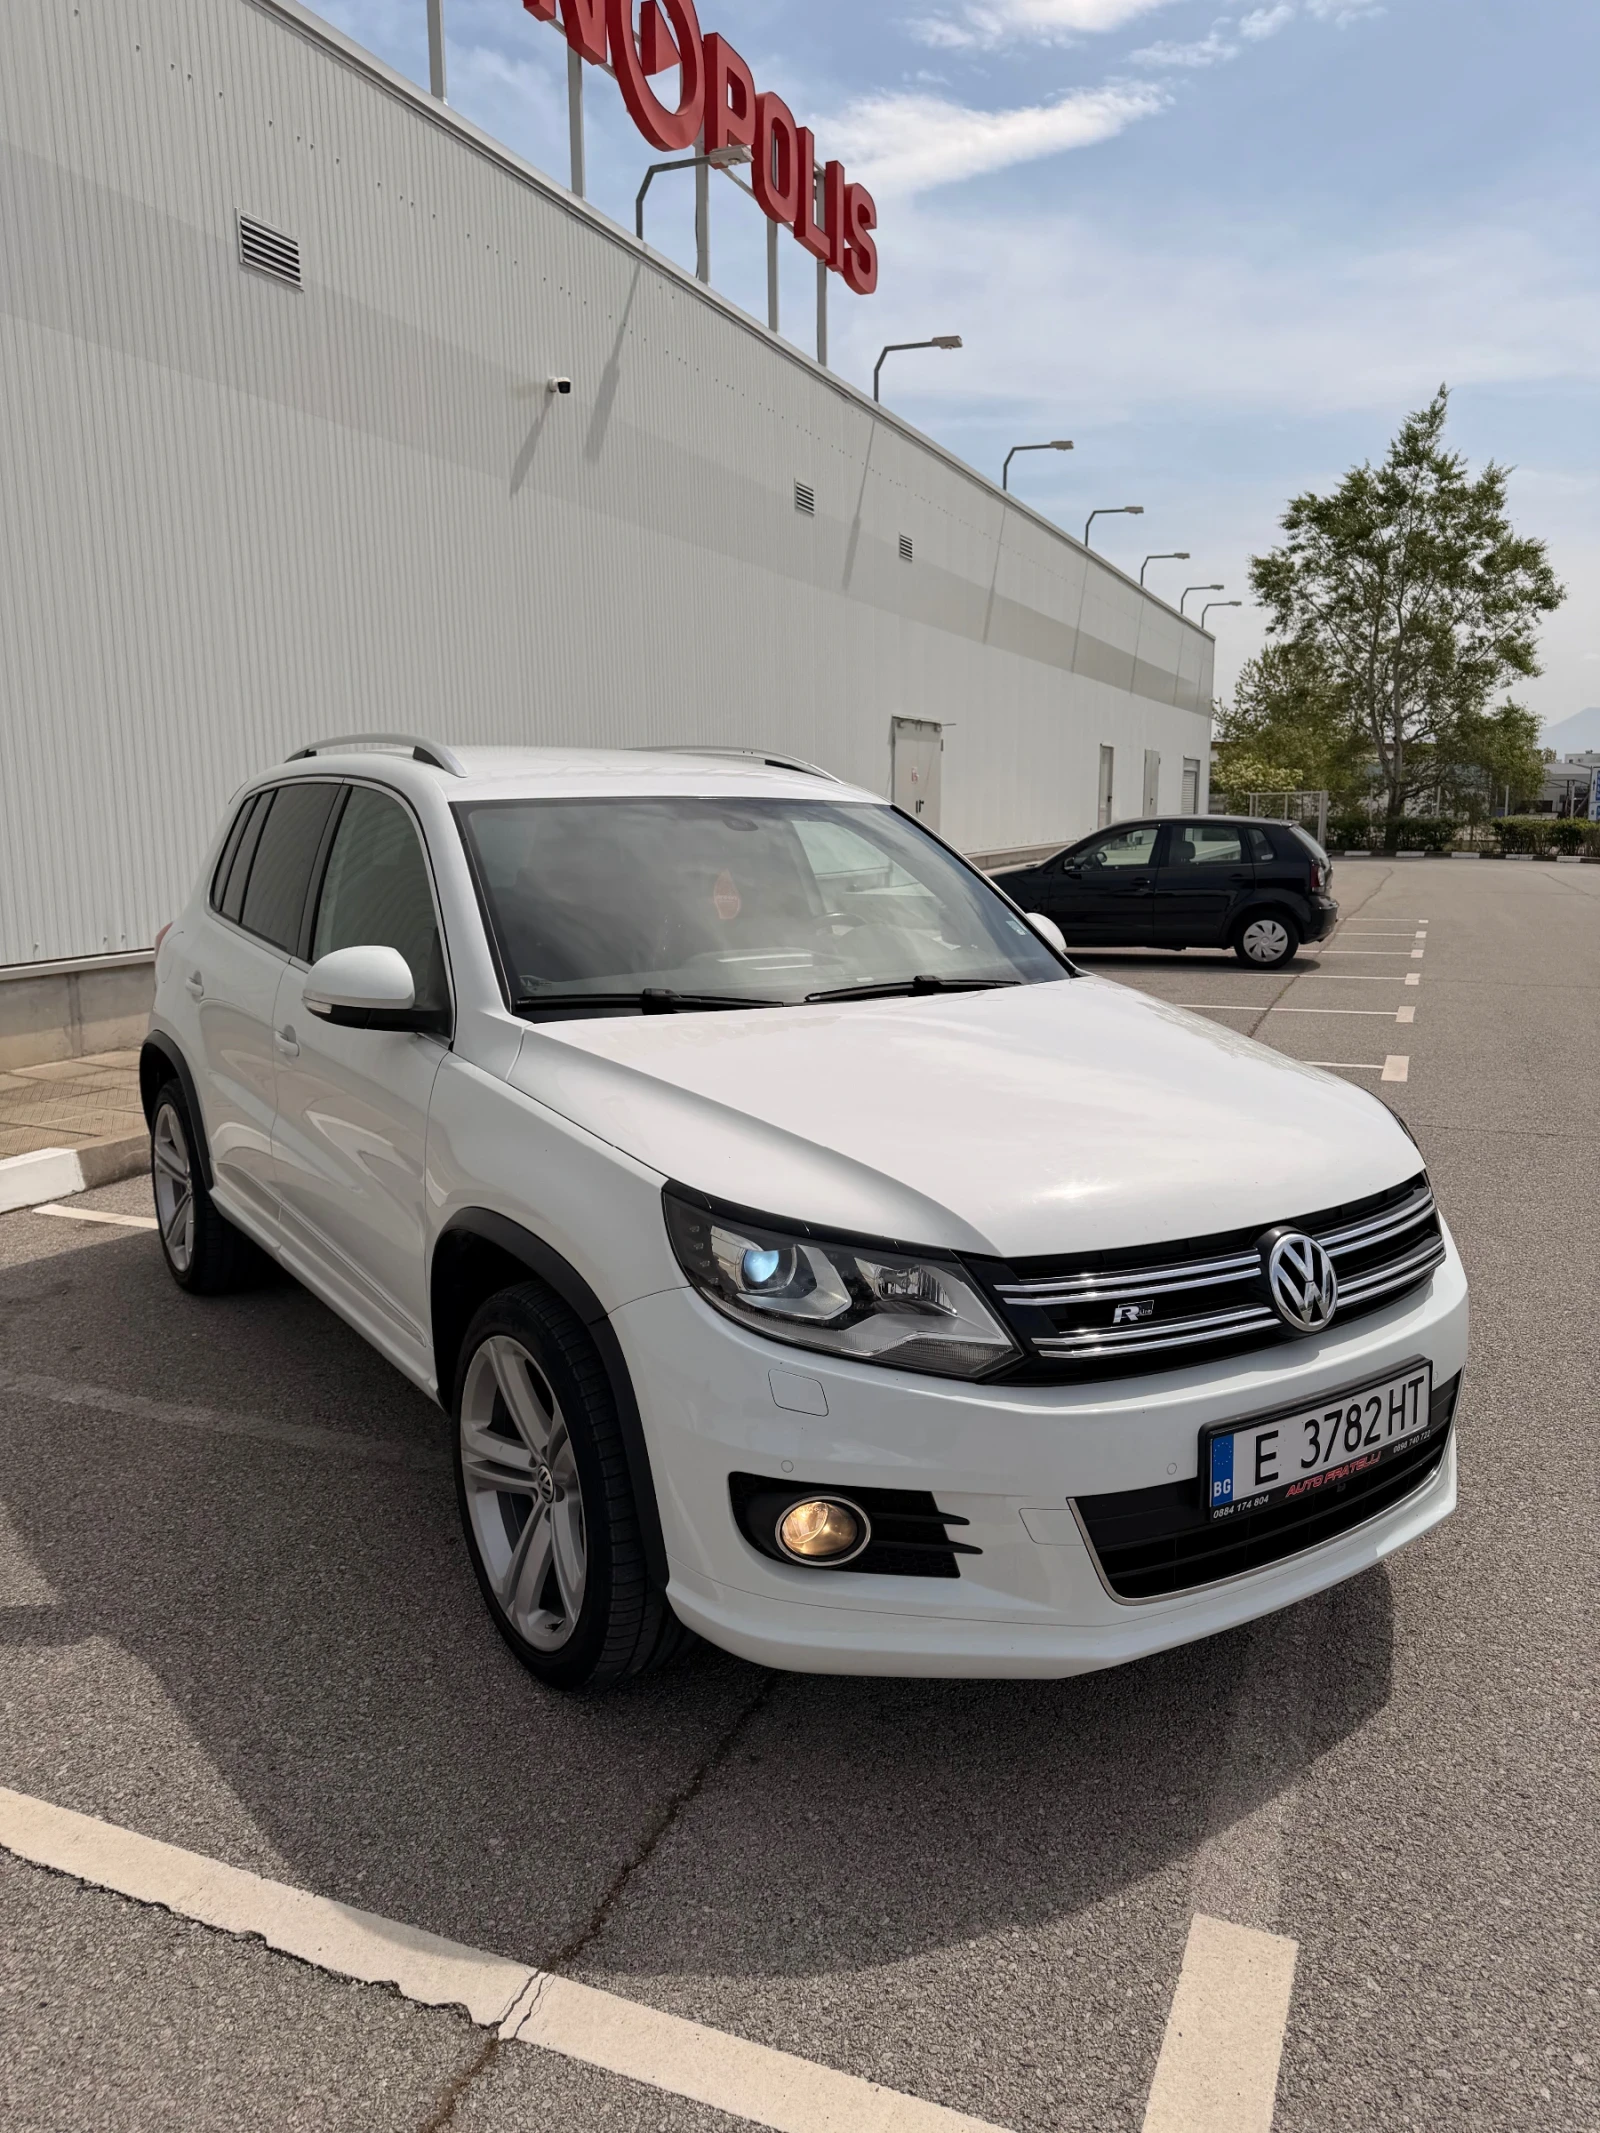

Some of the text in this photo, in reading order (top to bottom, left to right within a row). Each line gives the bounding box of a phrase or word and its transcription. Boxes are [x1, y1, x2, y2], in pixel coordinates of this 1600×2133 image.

[1269, 1233, 1338, 1332] VW
[1113, 1306, 1139, 1323] R
[1213, 1375, 1425, 1497] BG E 3782 HT
[1285, 1451, 1382, 1498] AUTO FRATELLI
[1213, 1494, 1269, 1519] 0884 174 804
